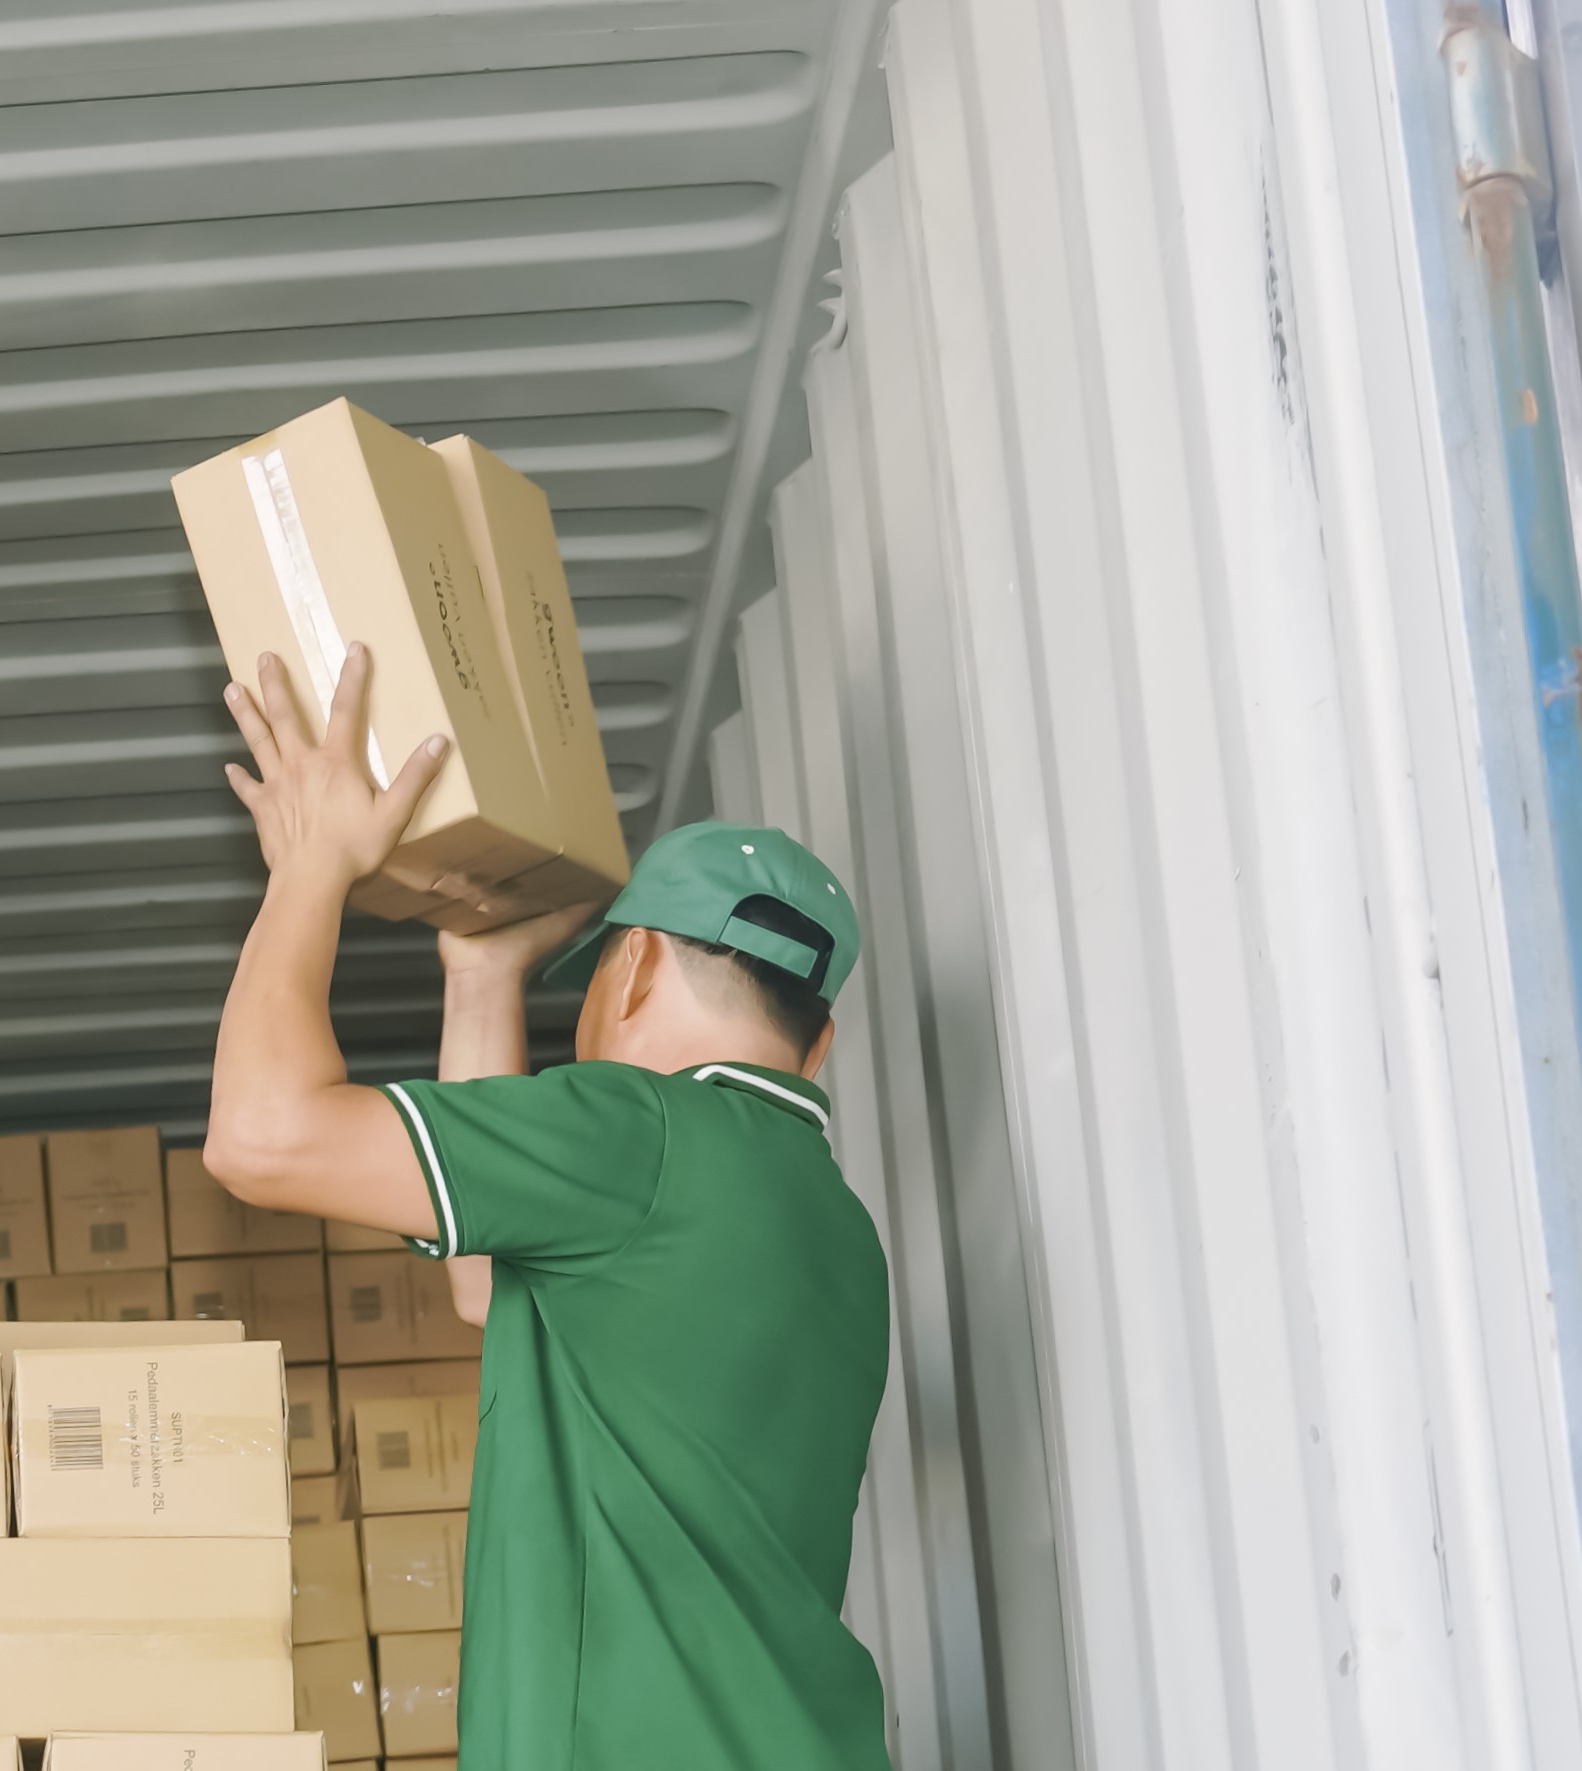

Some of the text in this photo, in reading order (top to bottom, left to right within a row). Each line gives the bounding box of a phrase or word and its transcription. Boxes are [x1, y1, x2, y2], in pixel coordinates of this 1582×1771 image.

[128, 1390, 141, 1489] 15 50 stuks
[152, 1492, 164, 1516] 25L
